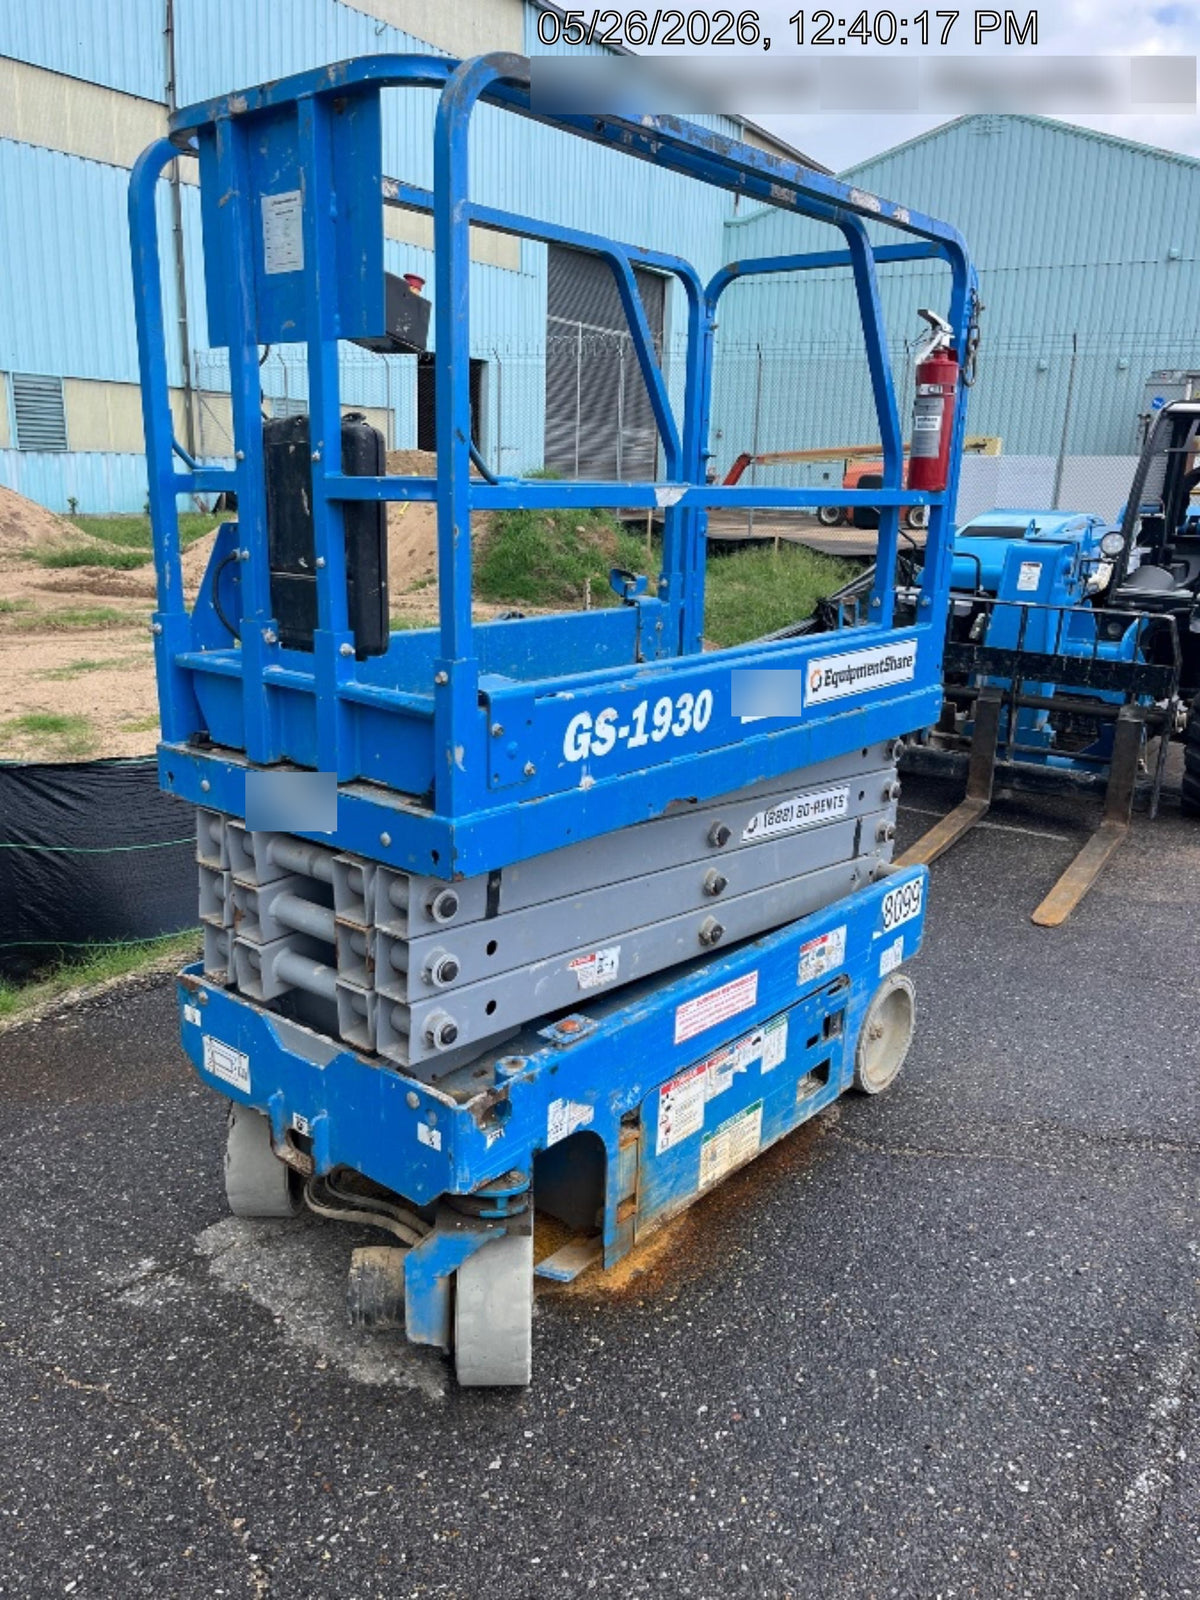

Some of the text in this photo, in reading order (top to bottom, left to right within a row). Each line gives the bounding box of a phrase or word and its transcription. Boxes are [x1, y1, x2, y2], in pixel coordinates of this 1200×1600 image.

[824, 655, 913, 688] EquipmentShare
[563, 689, 713, 762] GS-1930
[764, 805, 794, 828] (888)
[884, 879, 920, 929] 8099
